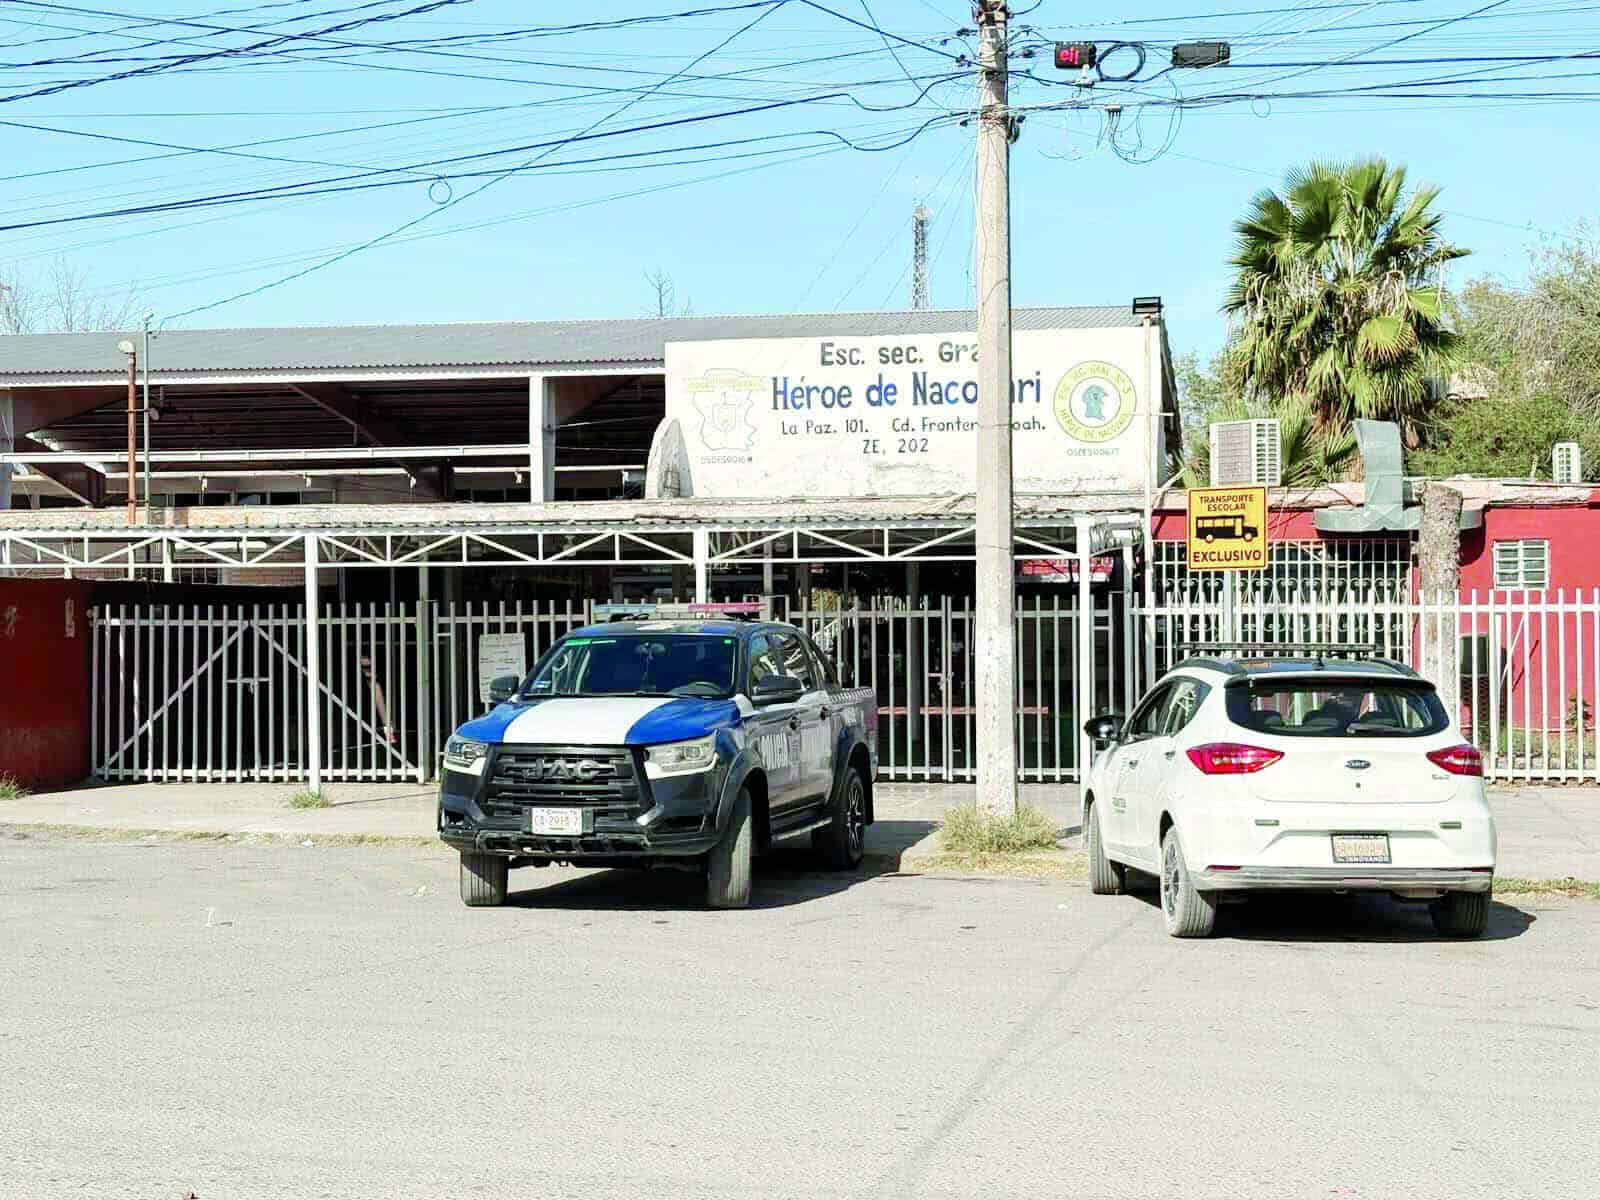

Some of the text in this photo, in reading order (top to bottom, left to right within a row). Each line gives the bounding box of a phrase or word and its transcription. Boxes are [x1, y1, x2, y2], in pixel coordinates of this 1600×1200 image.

[820, 342, 865, 366] Esc.
[878, 345, 924, 365] sec.
[772, 375, 852, 410] Héroe
[865, 372, 898, 407] de
[781, 420, 798, 435] La
[806, 419, 837, 434] Paz.
[845, 418, 869, 433] 101.
[892, 417, 916, 433] Cd.
[897, 437, 929, 453] 202
[1200, 494, 1254, 504] TRANSPORTE
[1207, 504, 1246, 512] ESCOLAR
[1193, 550, 1262, 562] EXCLUSIVO
